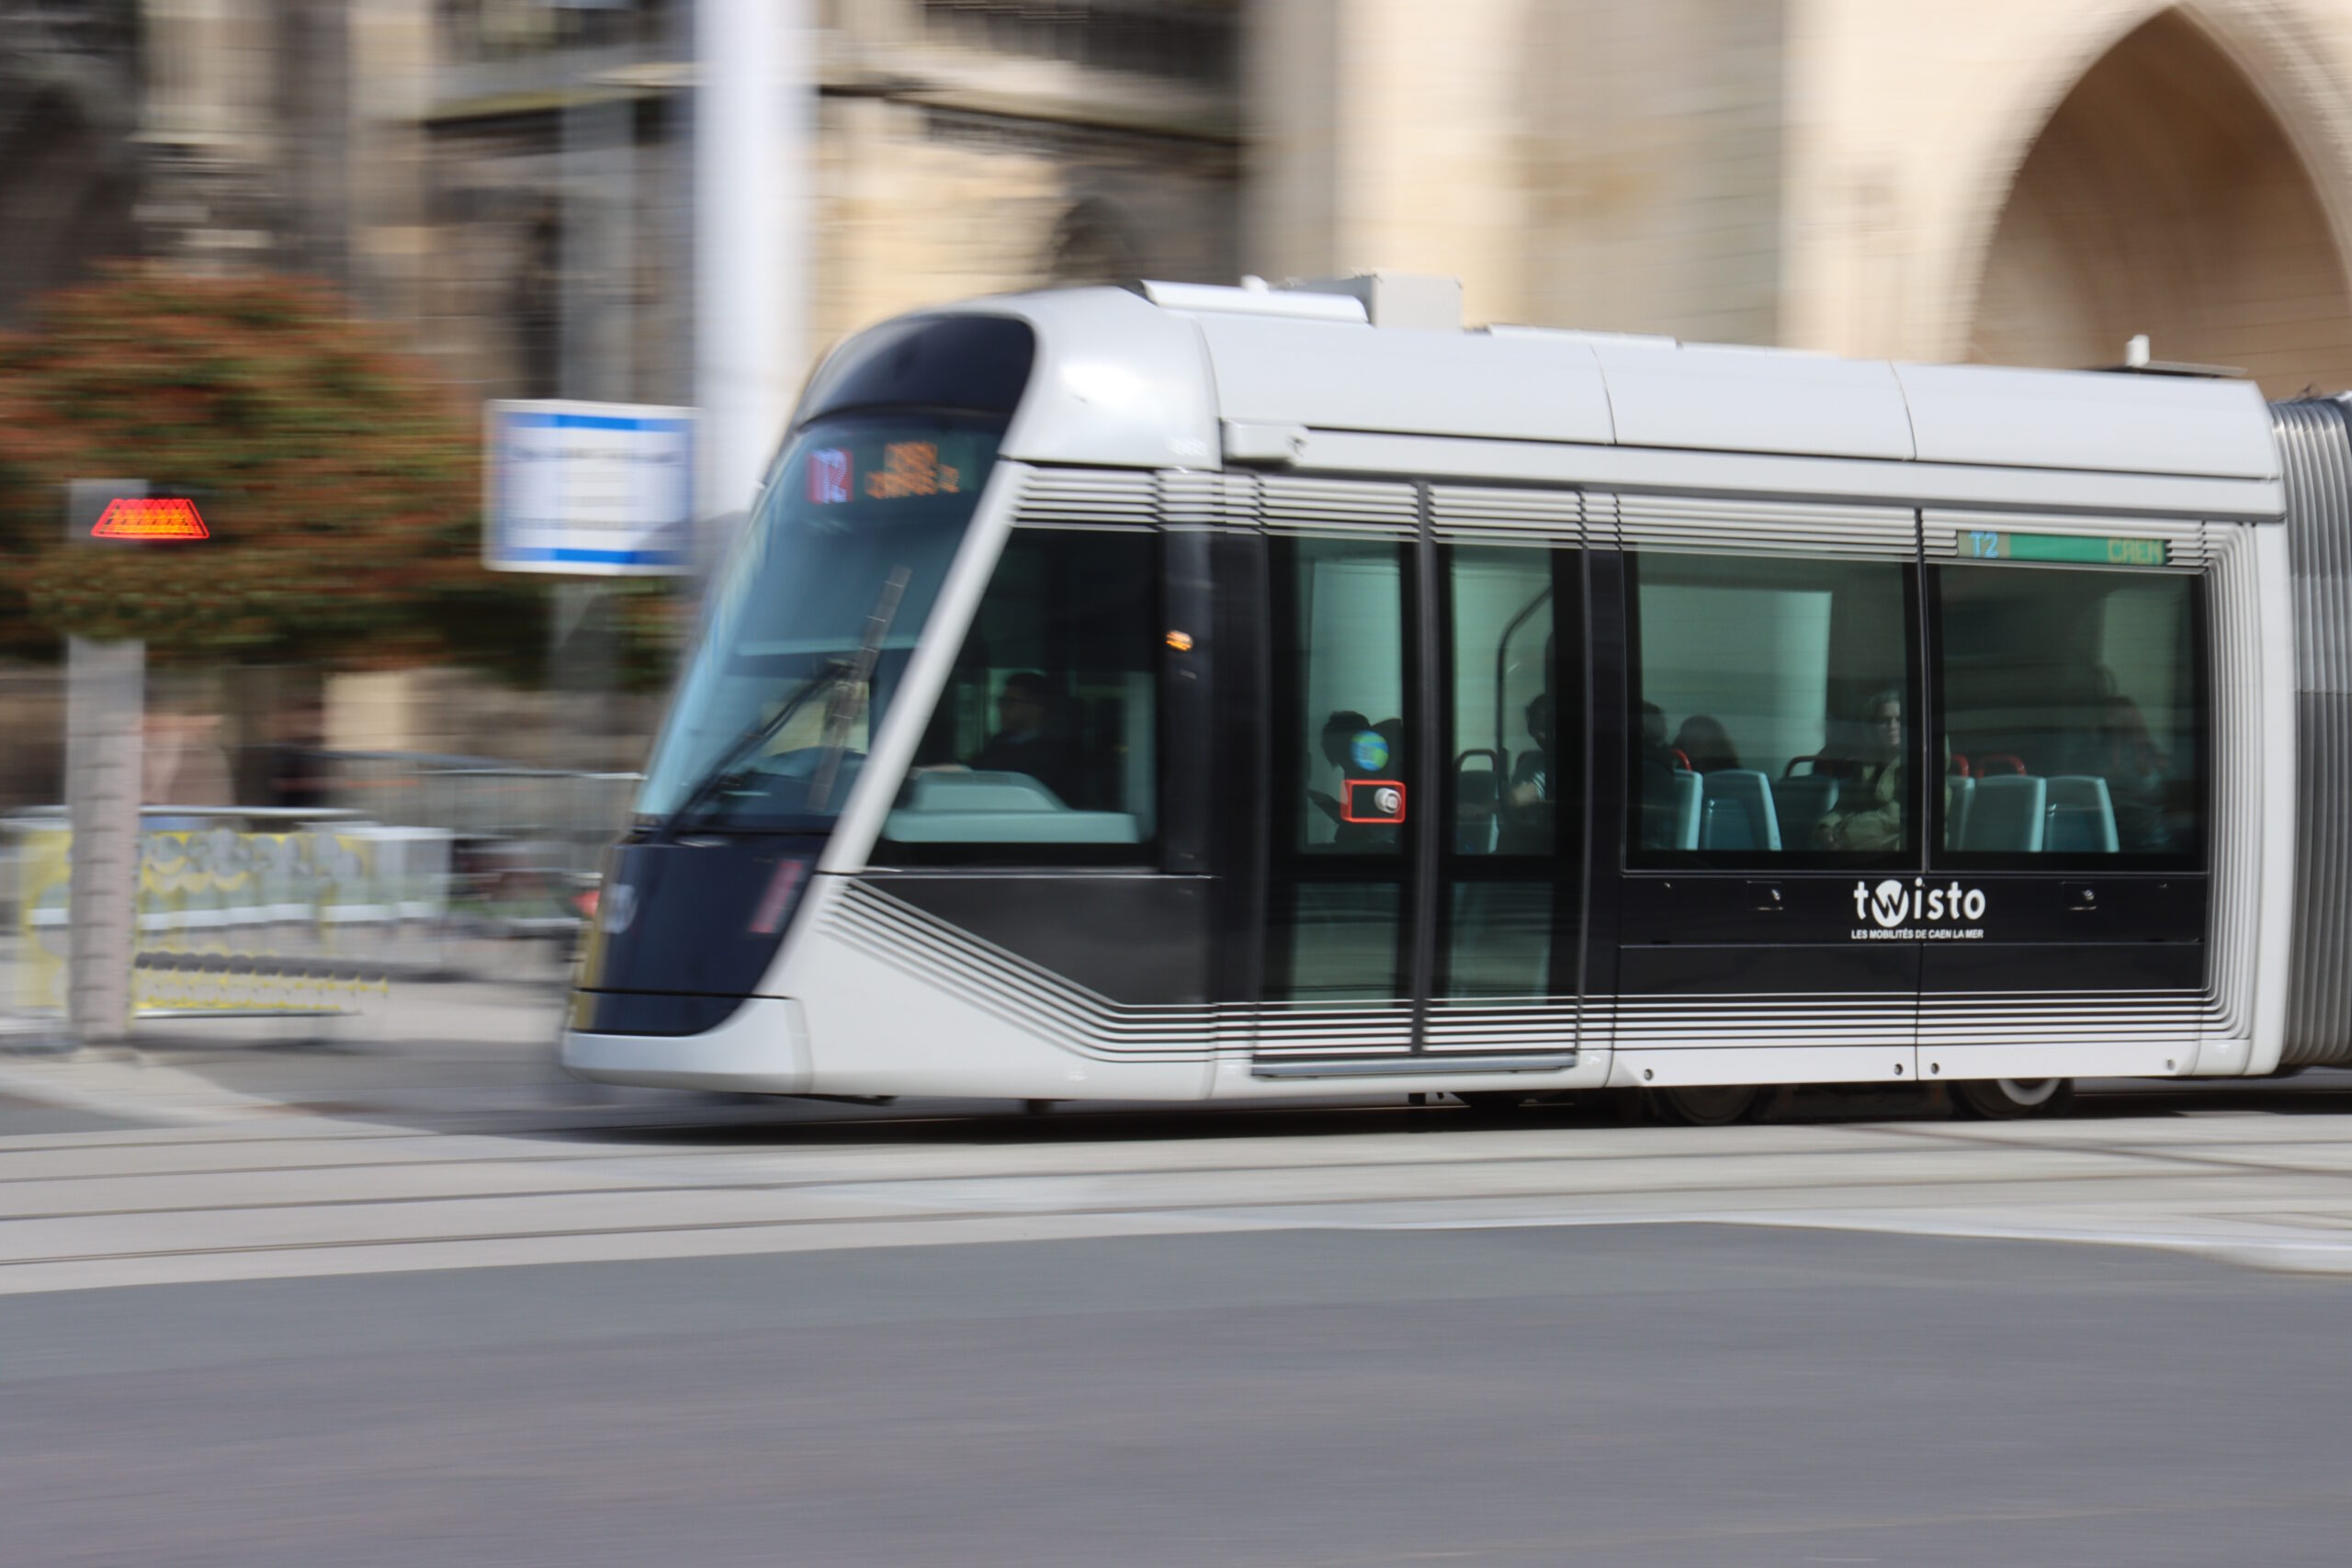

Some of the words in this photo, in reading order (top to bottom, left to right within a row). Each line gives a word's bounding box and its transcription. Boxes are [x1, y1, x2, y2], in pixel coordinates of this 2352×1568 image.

[1970, 531, 1999, 558] T2
[2109, 537, 2164, 565] CAEN
[1853, 876, 1985, 928] twisto
[1851, 930, 1868, 939] LES
[1869, 928, 1914, 939] MOBILITÉS
[1915, 930, 1927, 939] DE
[1928, 930, 1951, 939] CAEN
[1952, 930, 1964, 939] LA
[1965, 930, 1984, 939] MER
